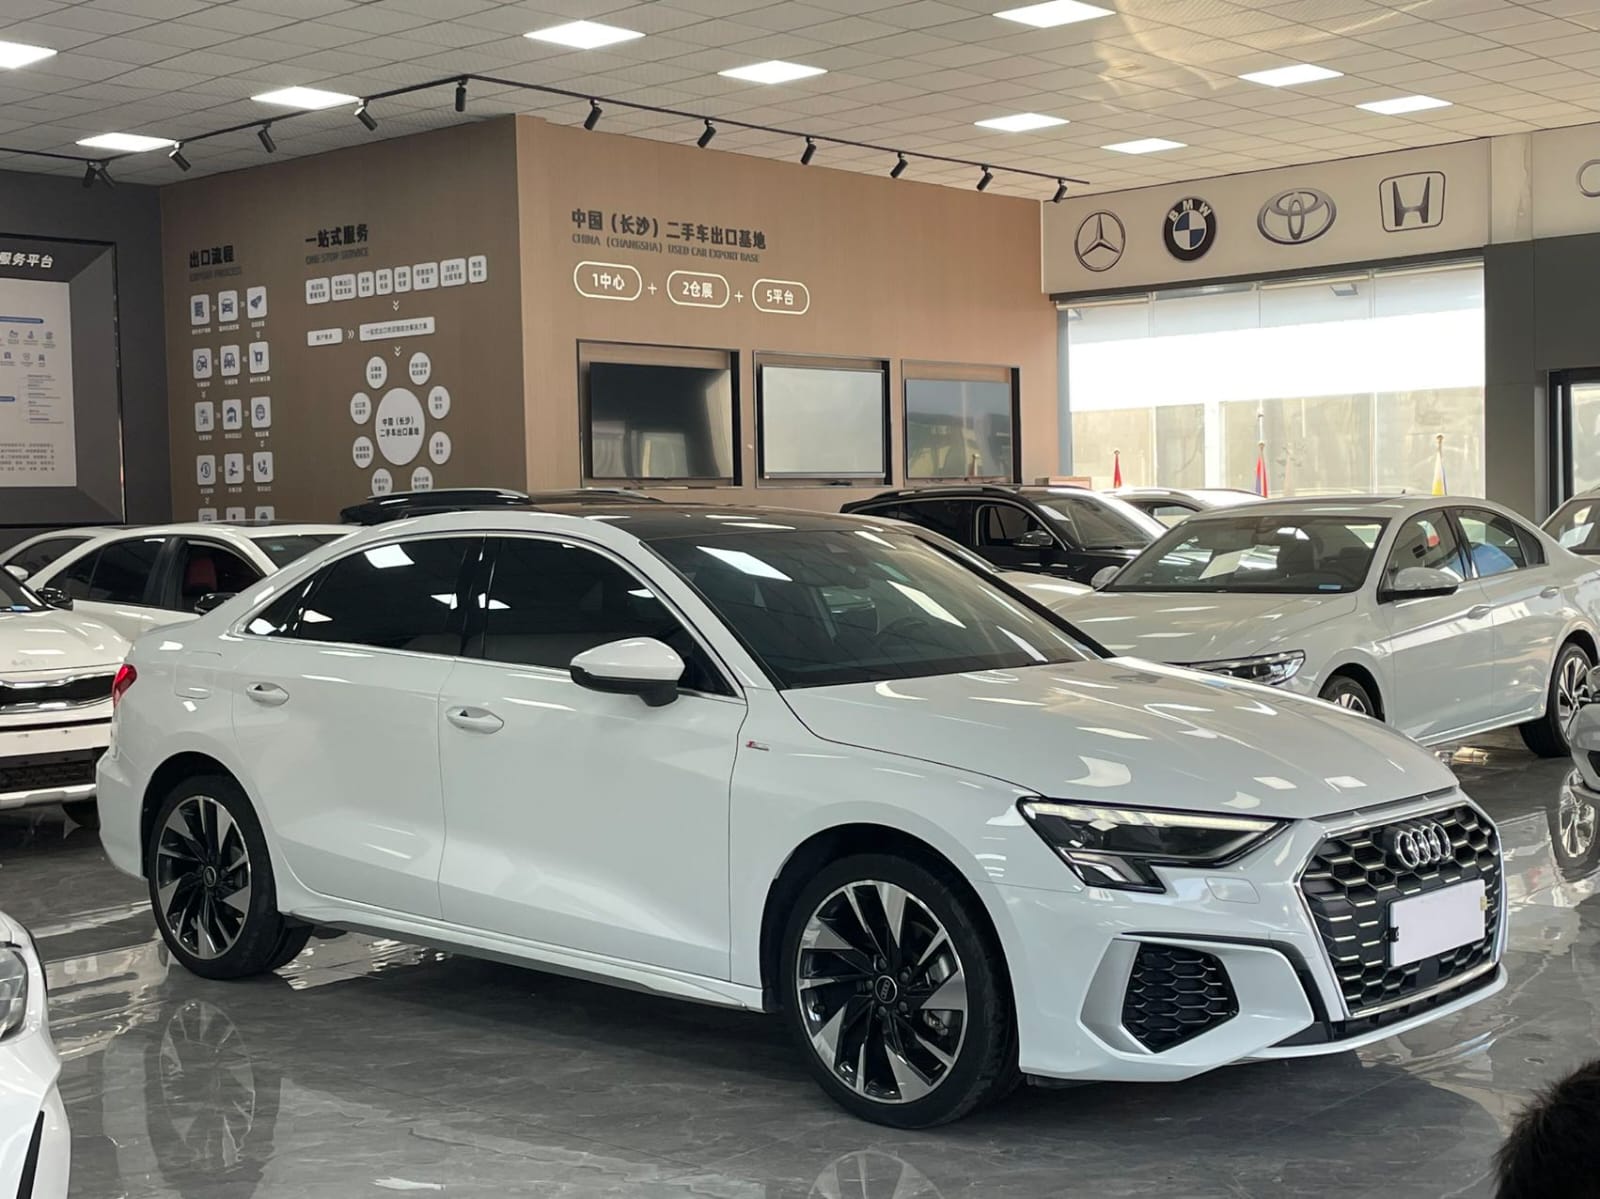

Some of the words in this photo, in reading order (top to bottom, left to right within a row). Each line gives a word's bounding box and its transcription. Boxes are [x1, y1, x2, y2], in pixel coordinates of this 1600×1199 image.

[1168, 199, 1212, 222] BMW
[305, 224, 369, 248] 一站式服务
[572, 208, 766, 250] 中国（长沙）二手车出口基地
[0, 251, 54, 269] 服务平台
[189, 245, 234, 268] 出口流程
[572, 233, 600, 245] CHINA
[668, 244, 689, 256] USED
[691, 247, 707, 258] CAR
[709, 249, 738, 260] EXPORT
[740, 252, 760, 263] BASE
[592, 272, 625, 291] 1中心
[766, 288, 794, 306] 5平台
